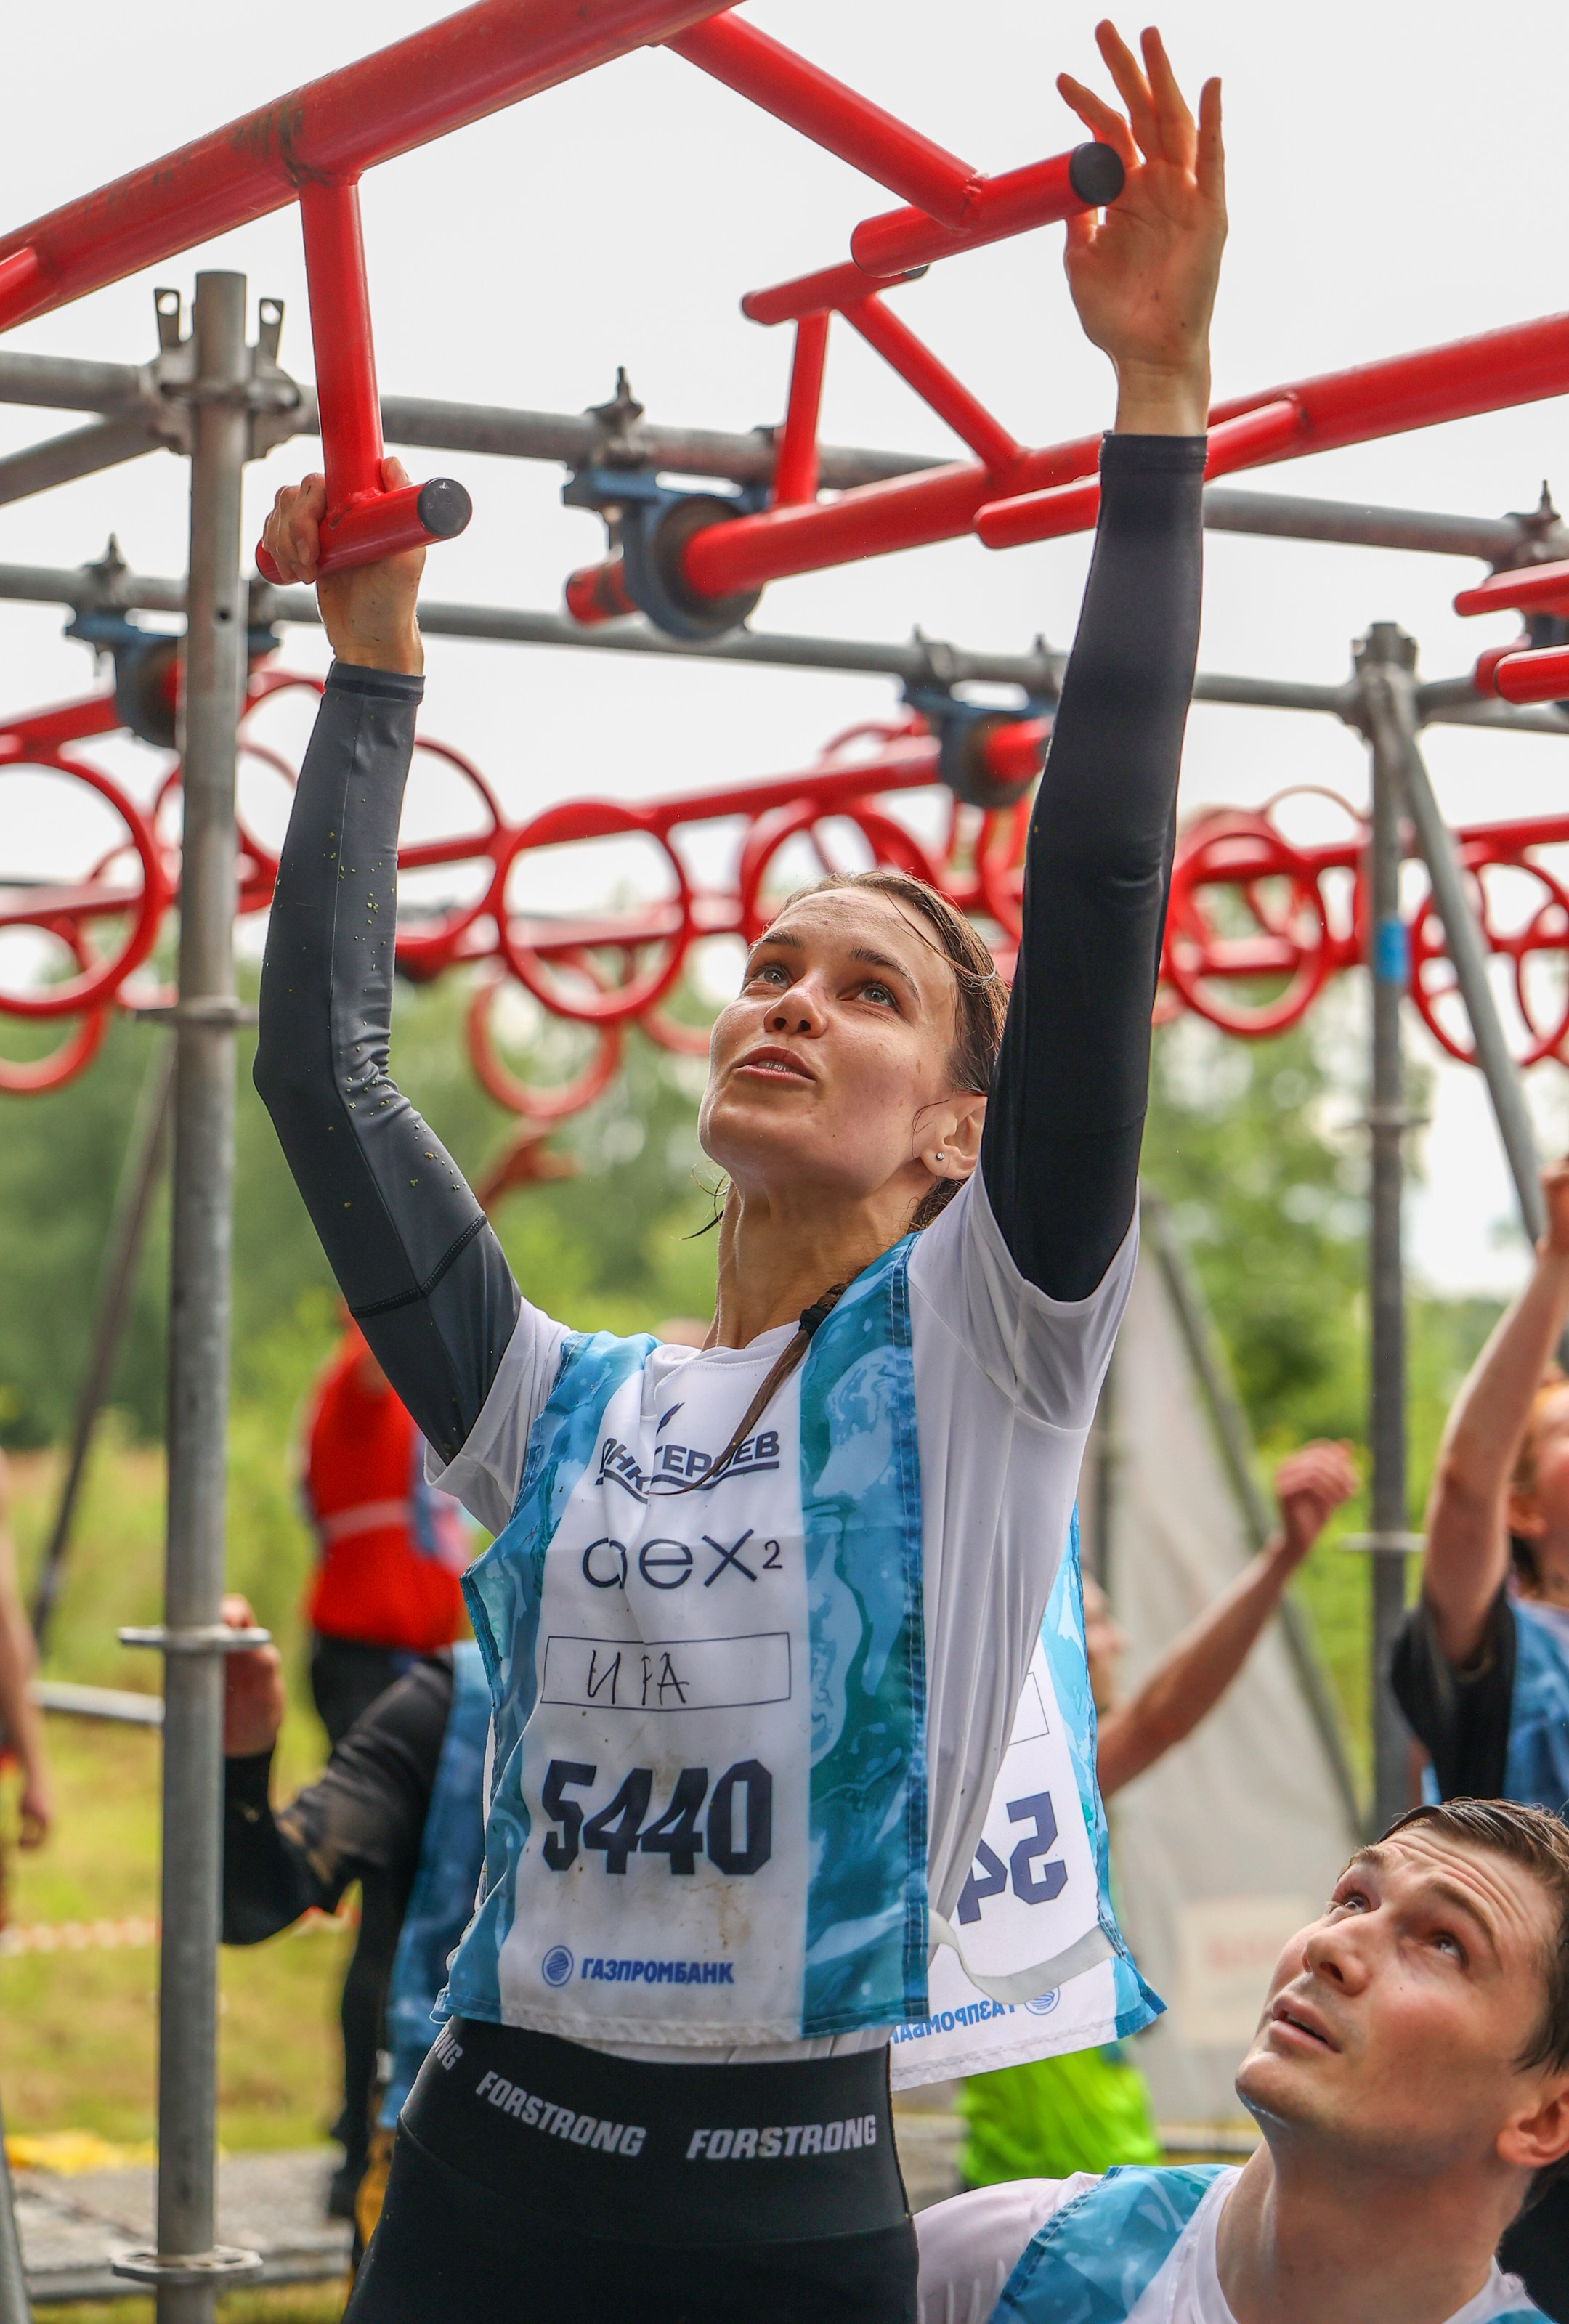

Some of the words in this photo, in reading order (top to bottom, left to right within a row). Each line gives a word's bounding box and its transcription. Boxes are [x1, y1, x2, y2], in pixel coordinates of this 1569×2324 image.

[654, 1431, 780, 1478] ЕРЕВ
[542, 1759, 773, 1875] 5440
[581, 1958, 734, 1984] ГАЗПРОМБАНК
[475, 2071, 647, 2157] FORSTRONG
[686, 2115, 877, 2161] FORSTRONG
